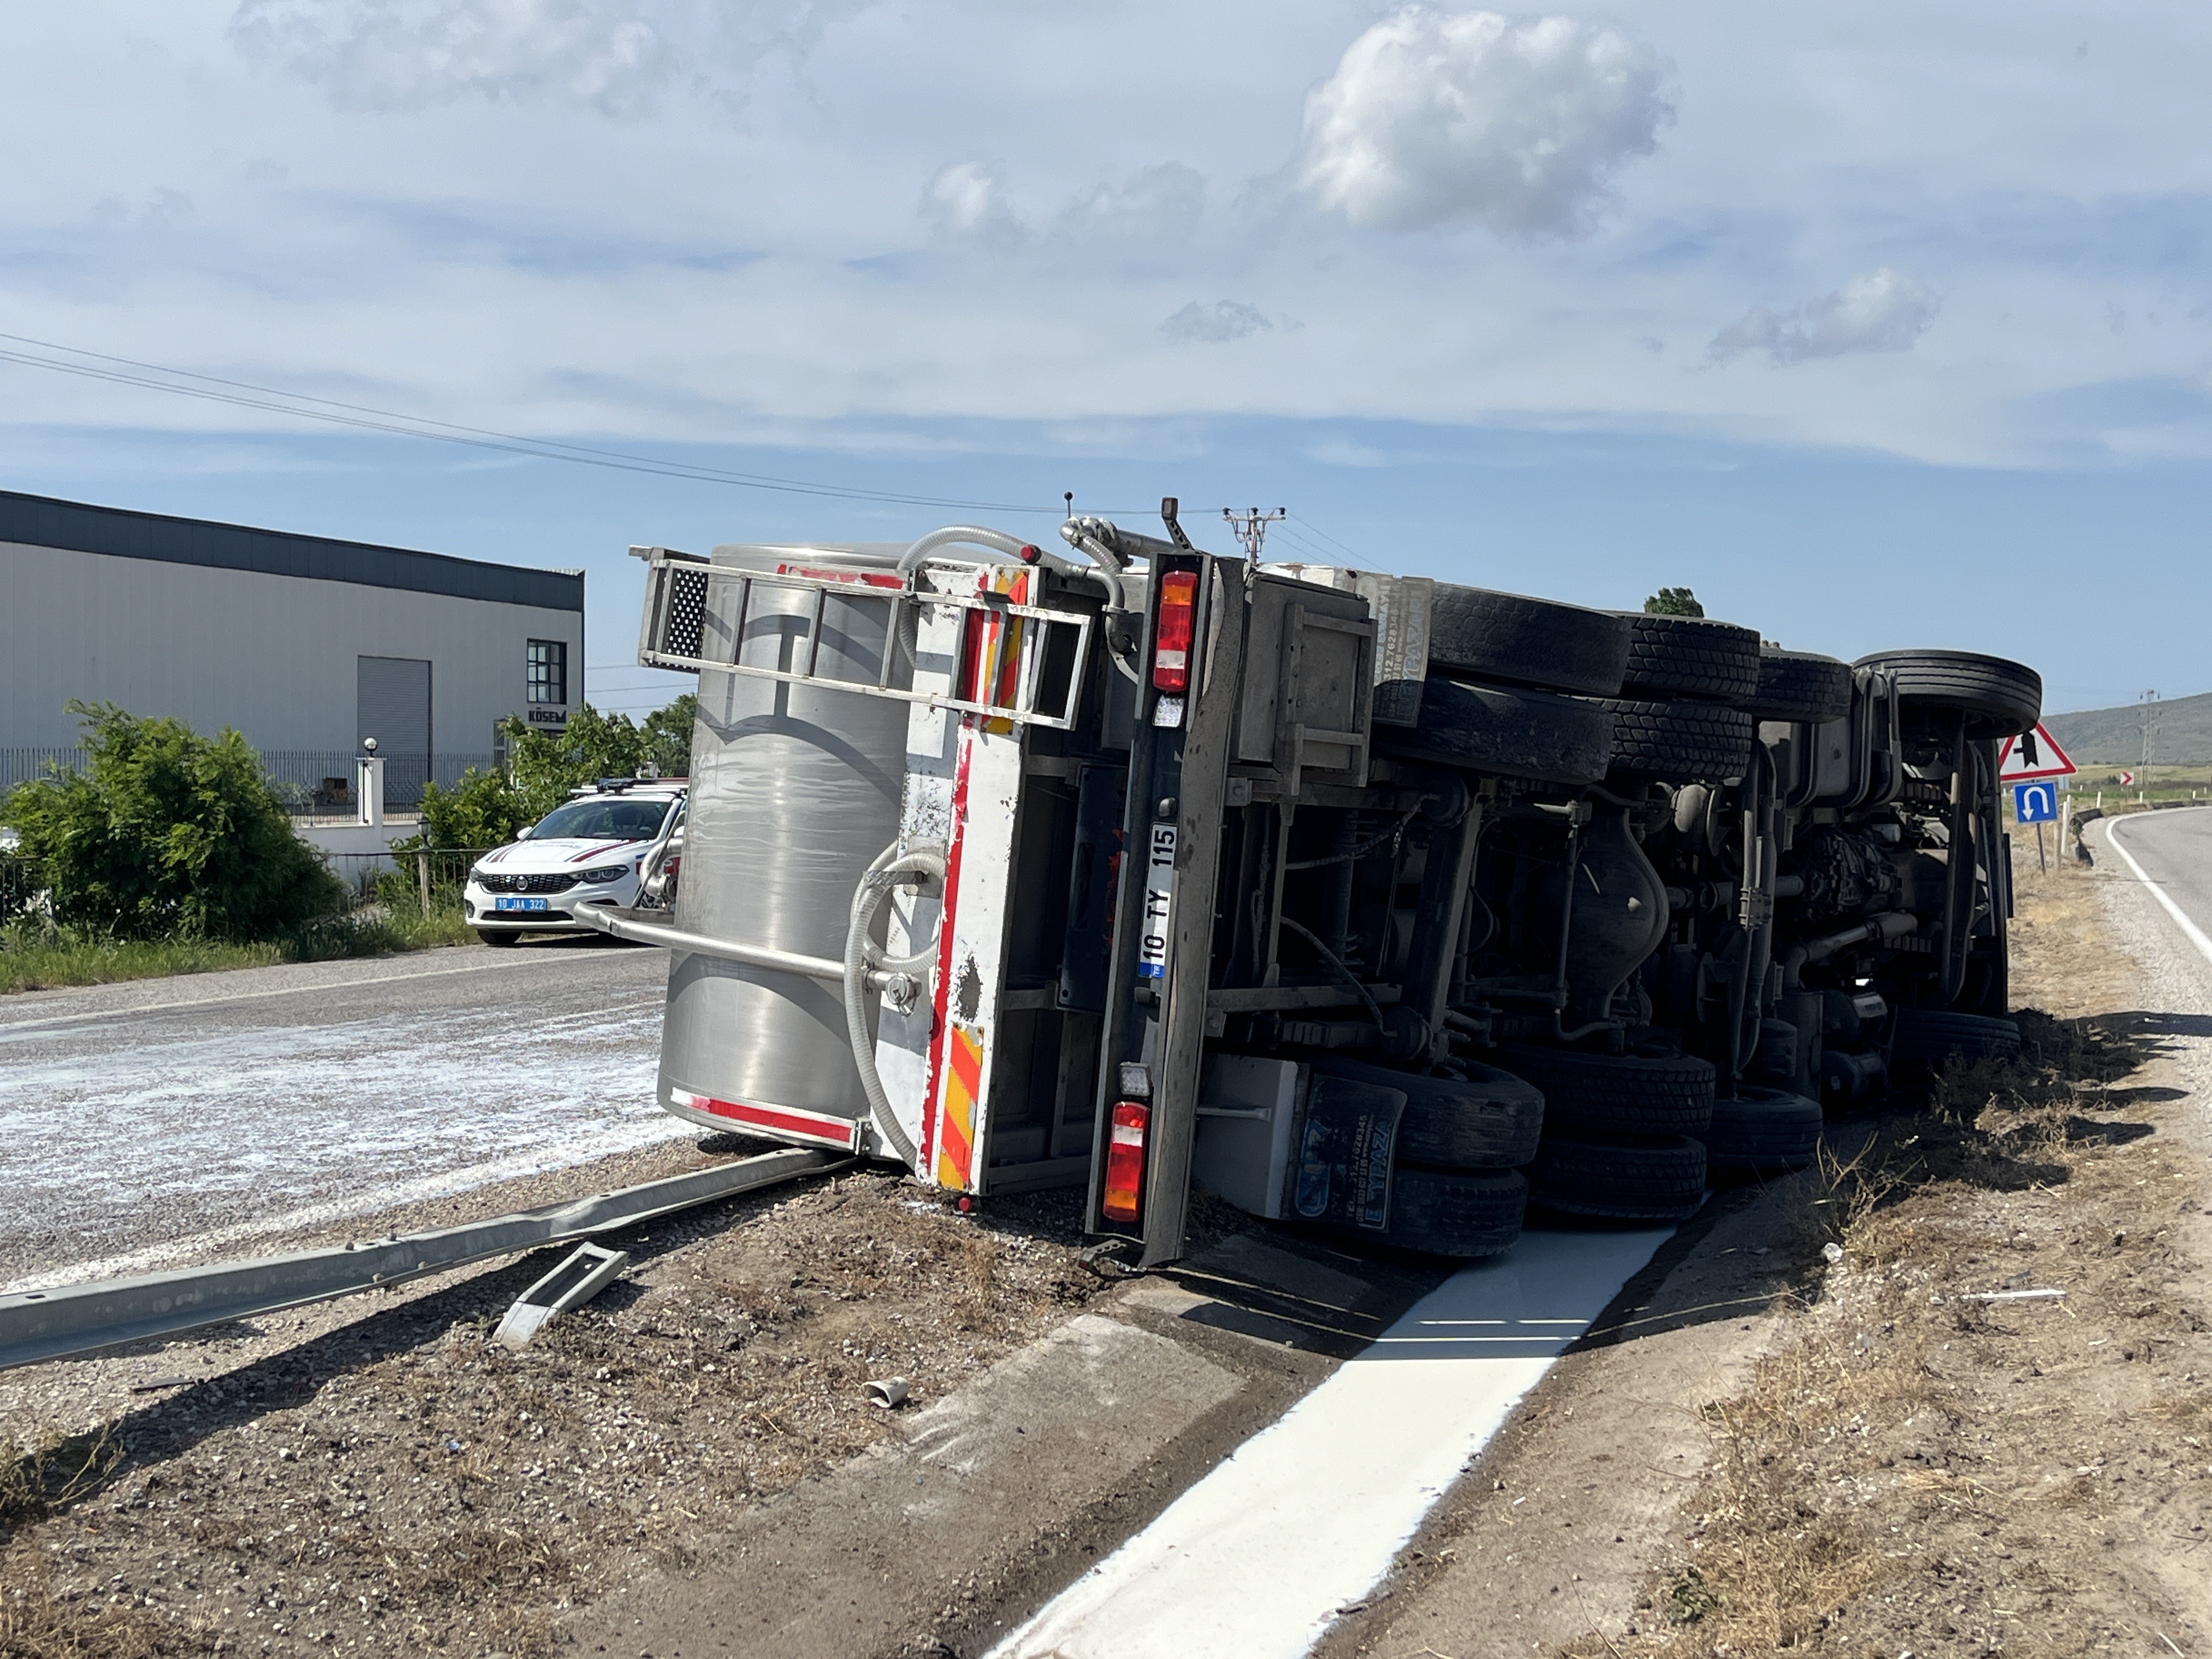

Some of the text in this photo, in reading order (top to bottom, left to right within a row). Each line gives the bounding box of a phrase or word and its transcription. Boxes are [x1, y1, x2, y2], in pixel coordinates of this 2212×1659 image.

[528, 707, 567, 723] KÖSEM
[1152, 830, 1175, 866] 115
[499, 899, 544, 909] 10 JAA 322
[1147, 889, 1169, 919] TY
[1143, 934, 1165, 959] 10
